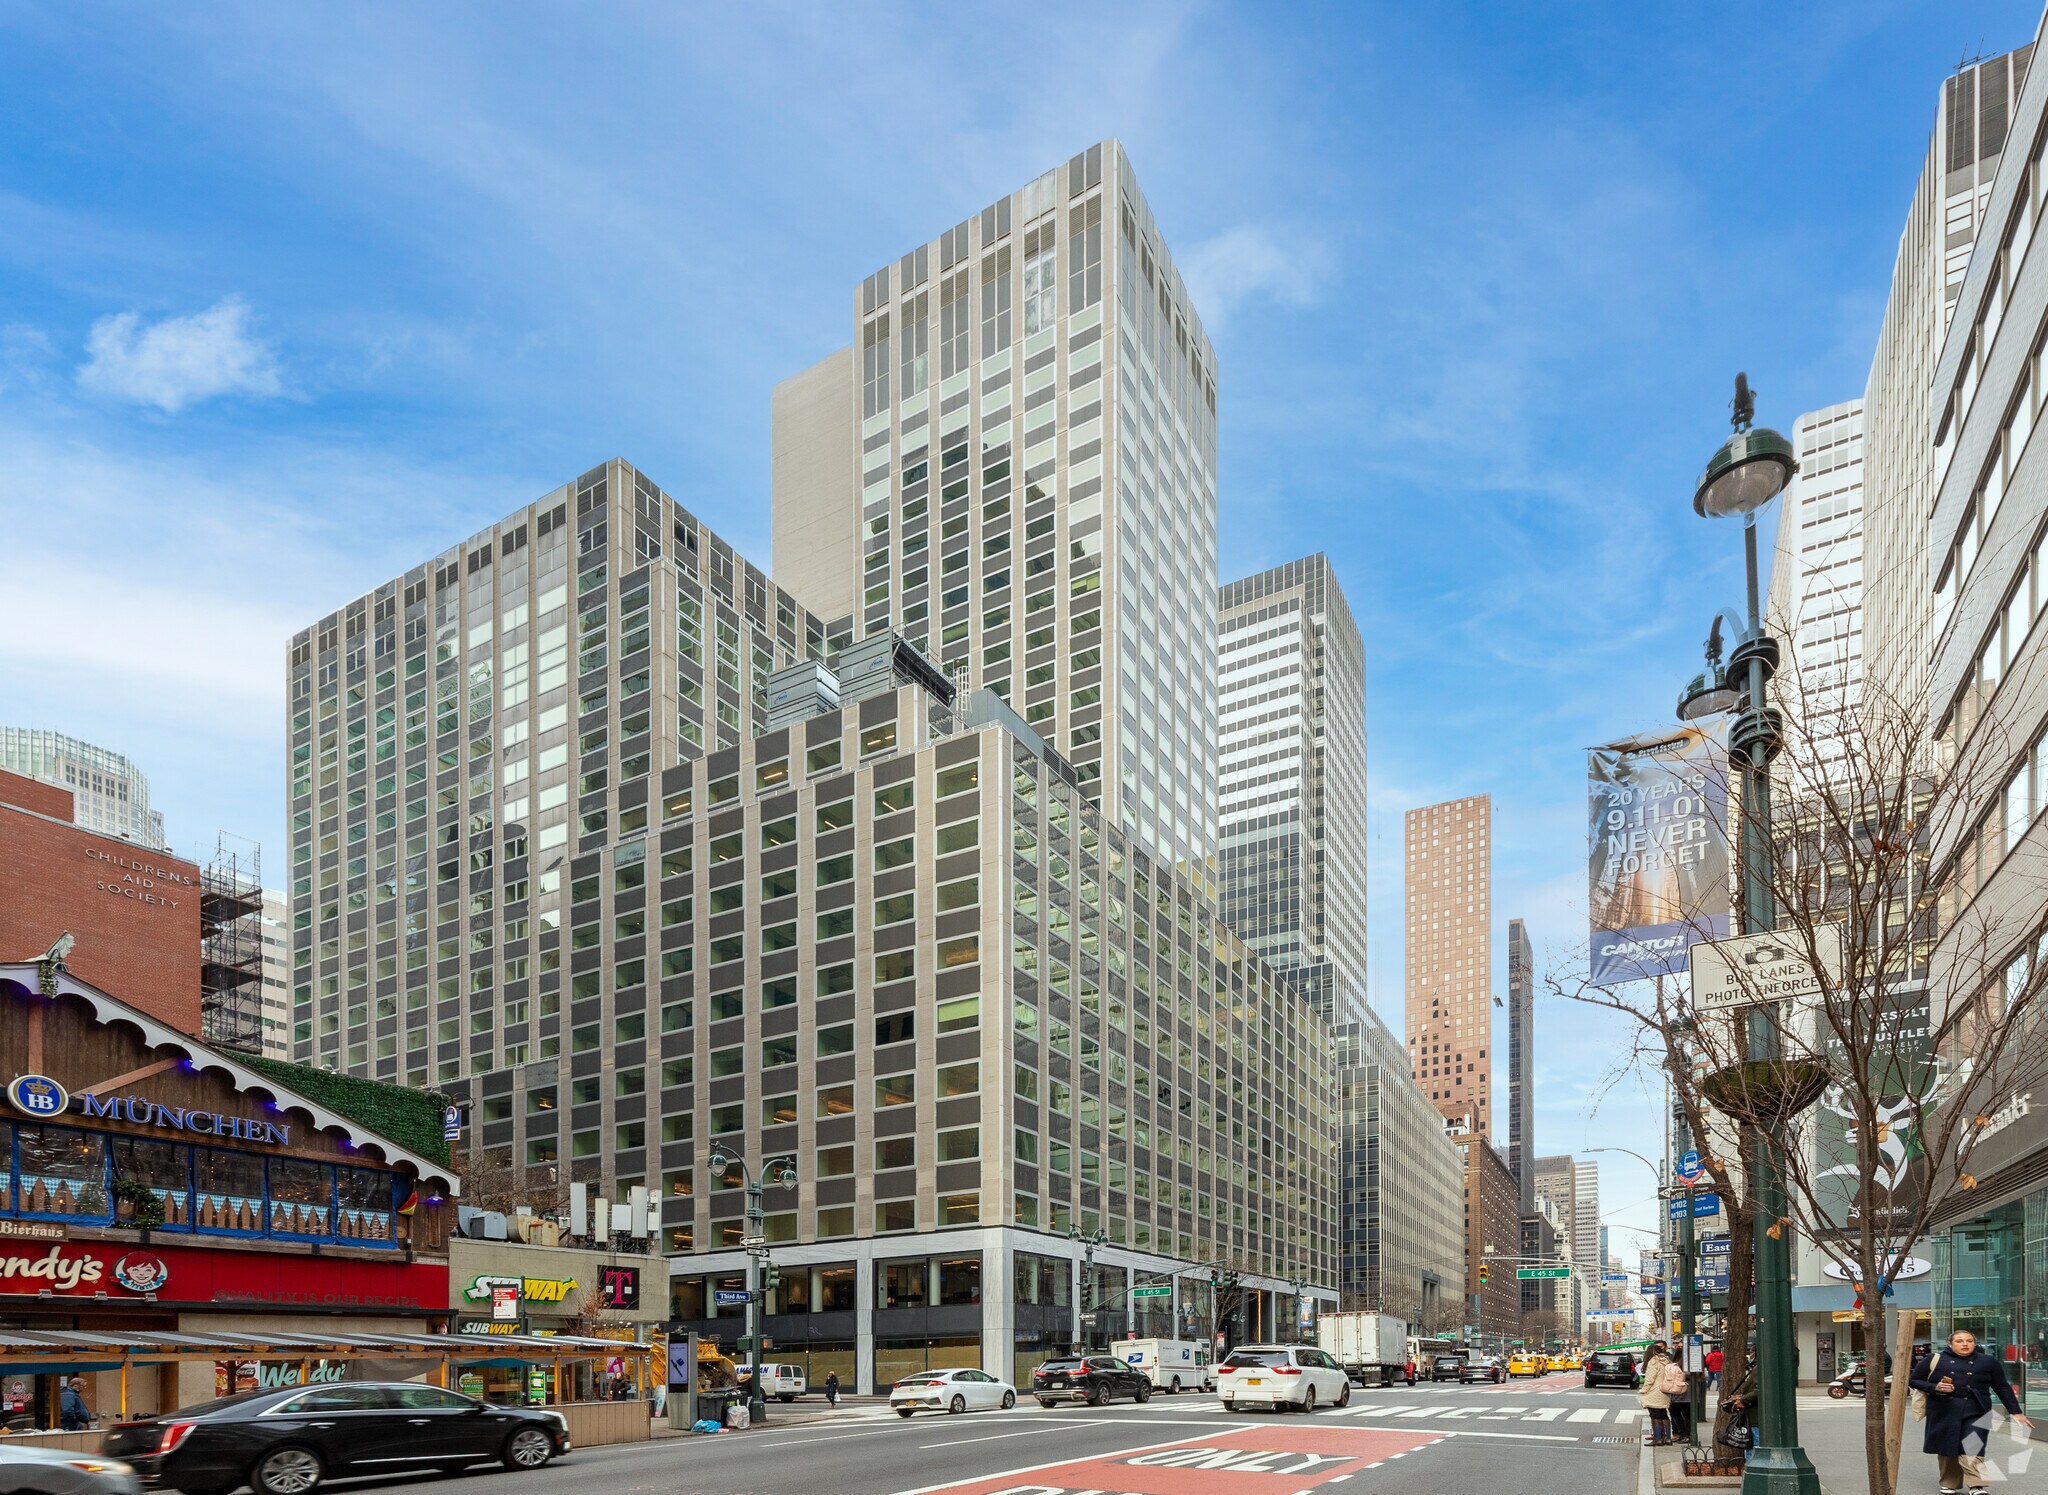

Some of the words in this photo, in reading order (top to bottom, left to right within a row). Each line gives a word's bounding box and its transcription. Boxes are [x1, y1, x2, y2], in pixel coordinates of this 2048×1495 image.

[1608, 790, 1633, 808] 20
[1637, 773, 1706, 802] YEARS
[1607, 791, 1706, 831] 9.11.01
[1608, 817, 1707, 856] NEVER
[85, 848, 190, 885] CHILDRENS
[1608, 840, 1711, 877] FORGET
[122, 873, 154, 889] AID
[97, 880, 179, 909] SOCIETY
[1600, 935, 1685, 957] CANTOR
[1726, 973, 1748, 986] BU
[1760, 963, 1805, 980] LANES
[1705, 987, 1748, 1004] PHOTO
[1756, 976, 1822, 997] ENFORCE
[1868, 1006, 1929, 1022] ESULT
[27, 1093, 54, 1110] HB
[81, 1092, 291, 1145] MÜNCHEN
[1671, 1200, 1688, 1209] M102
[1671, 1210, 1688, 1219] M103
[0, 1220, 64, 1238] Bierhaus
[1705, 1243, 1730, 1252] East
[0, 1245, 104, 1290] ndy's
[466, 1276, 578, 1301] SWAY
[720, 1292, 735, 1300] Third
[461, 1322, 521, 1335] SUBWAY
[260, 1359, 346, 1388] Wedy'
[736, 1366, 770, 1375] AMERAN
[1127, 1448, 1361, 1474] ONLY
